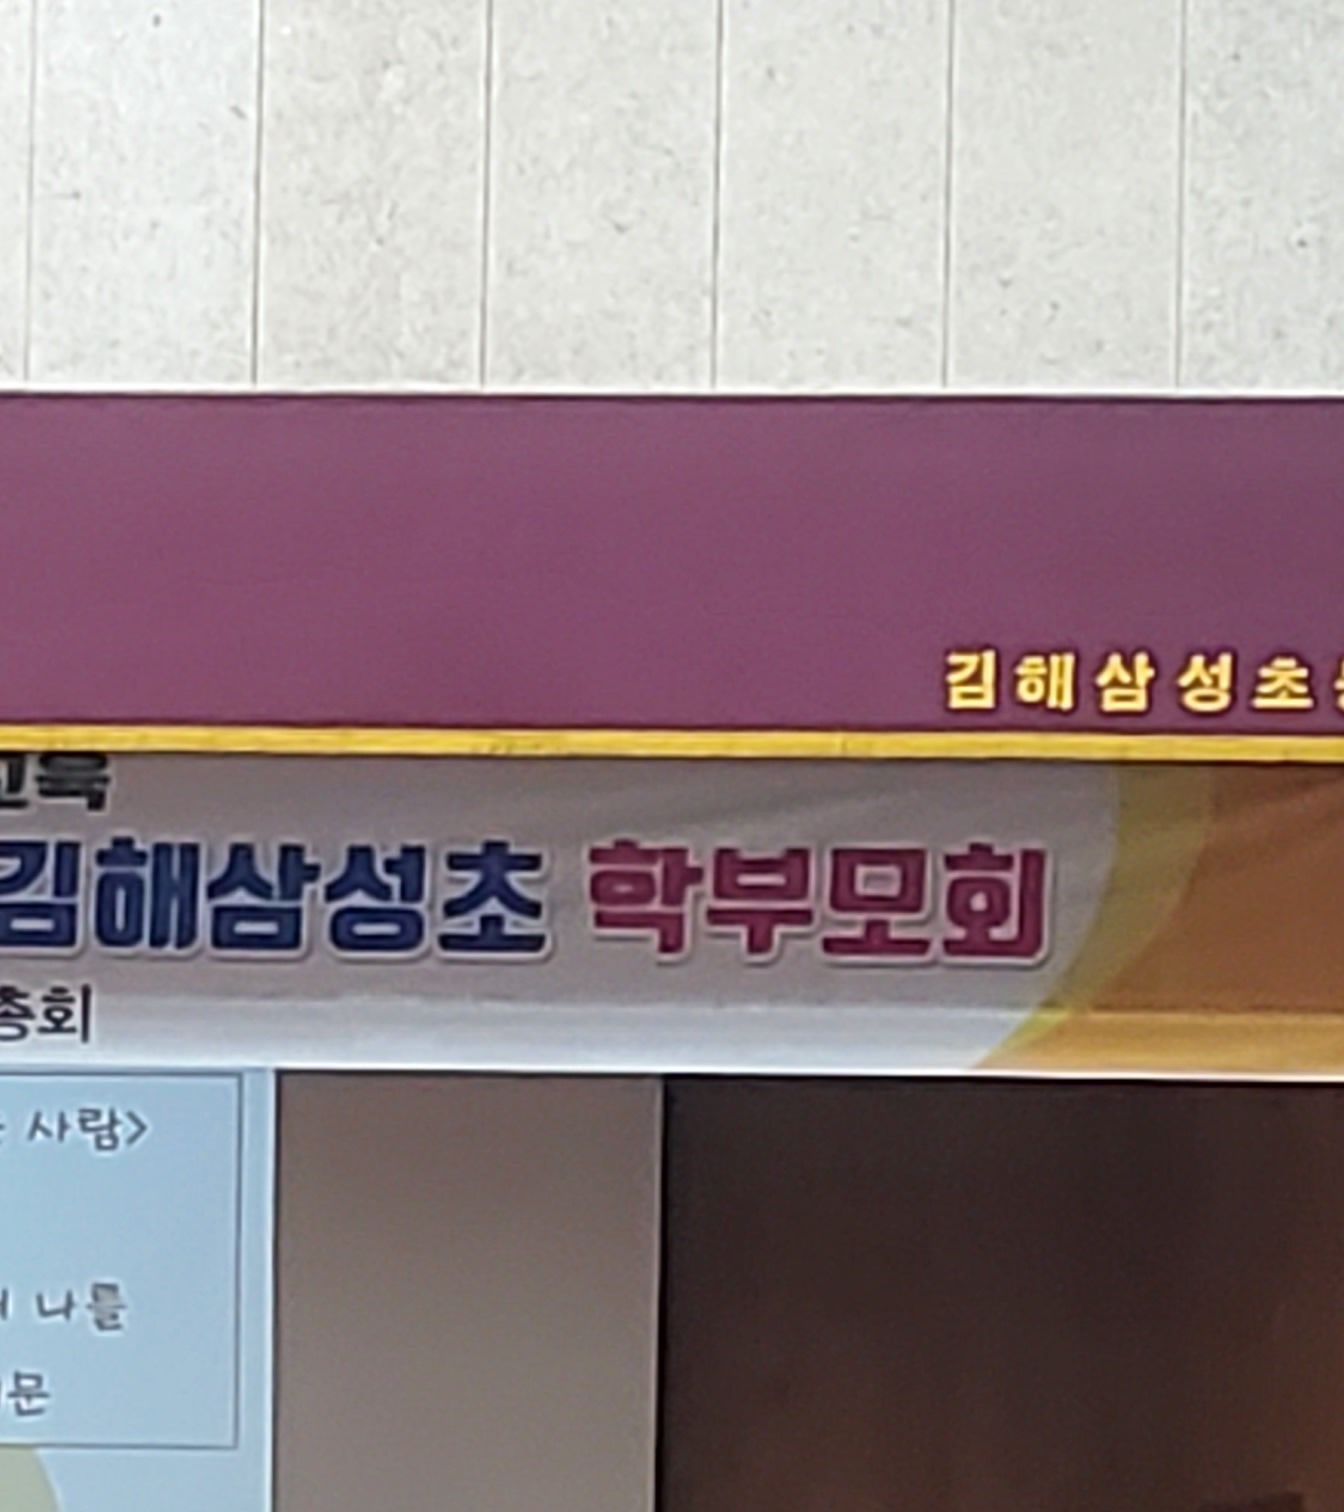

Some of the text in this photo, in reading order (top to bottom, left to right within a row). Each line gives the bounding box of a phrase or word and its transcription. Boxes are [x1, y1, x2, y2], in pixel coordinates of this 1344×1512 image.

[945, 649, 1344, 713] 김해삼성초
[589, 838, 1048, 958] 학부모회
[34, 1282, 128, 1333] 나를
